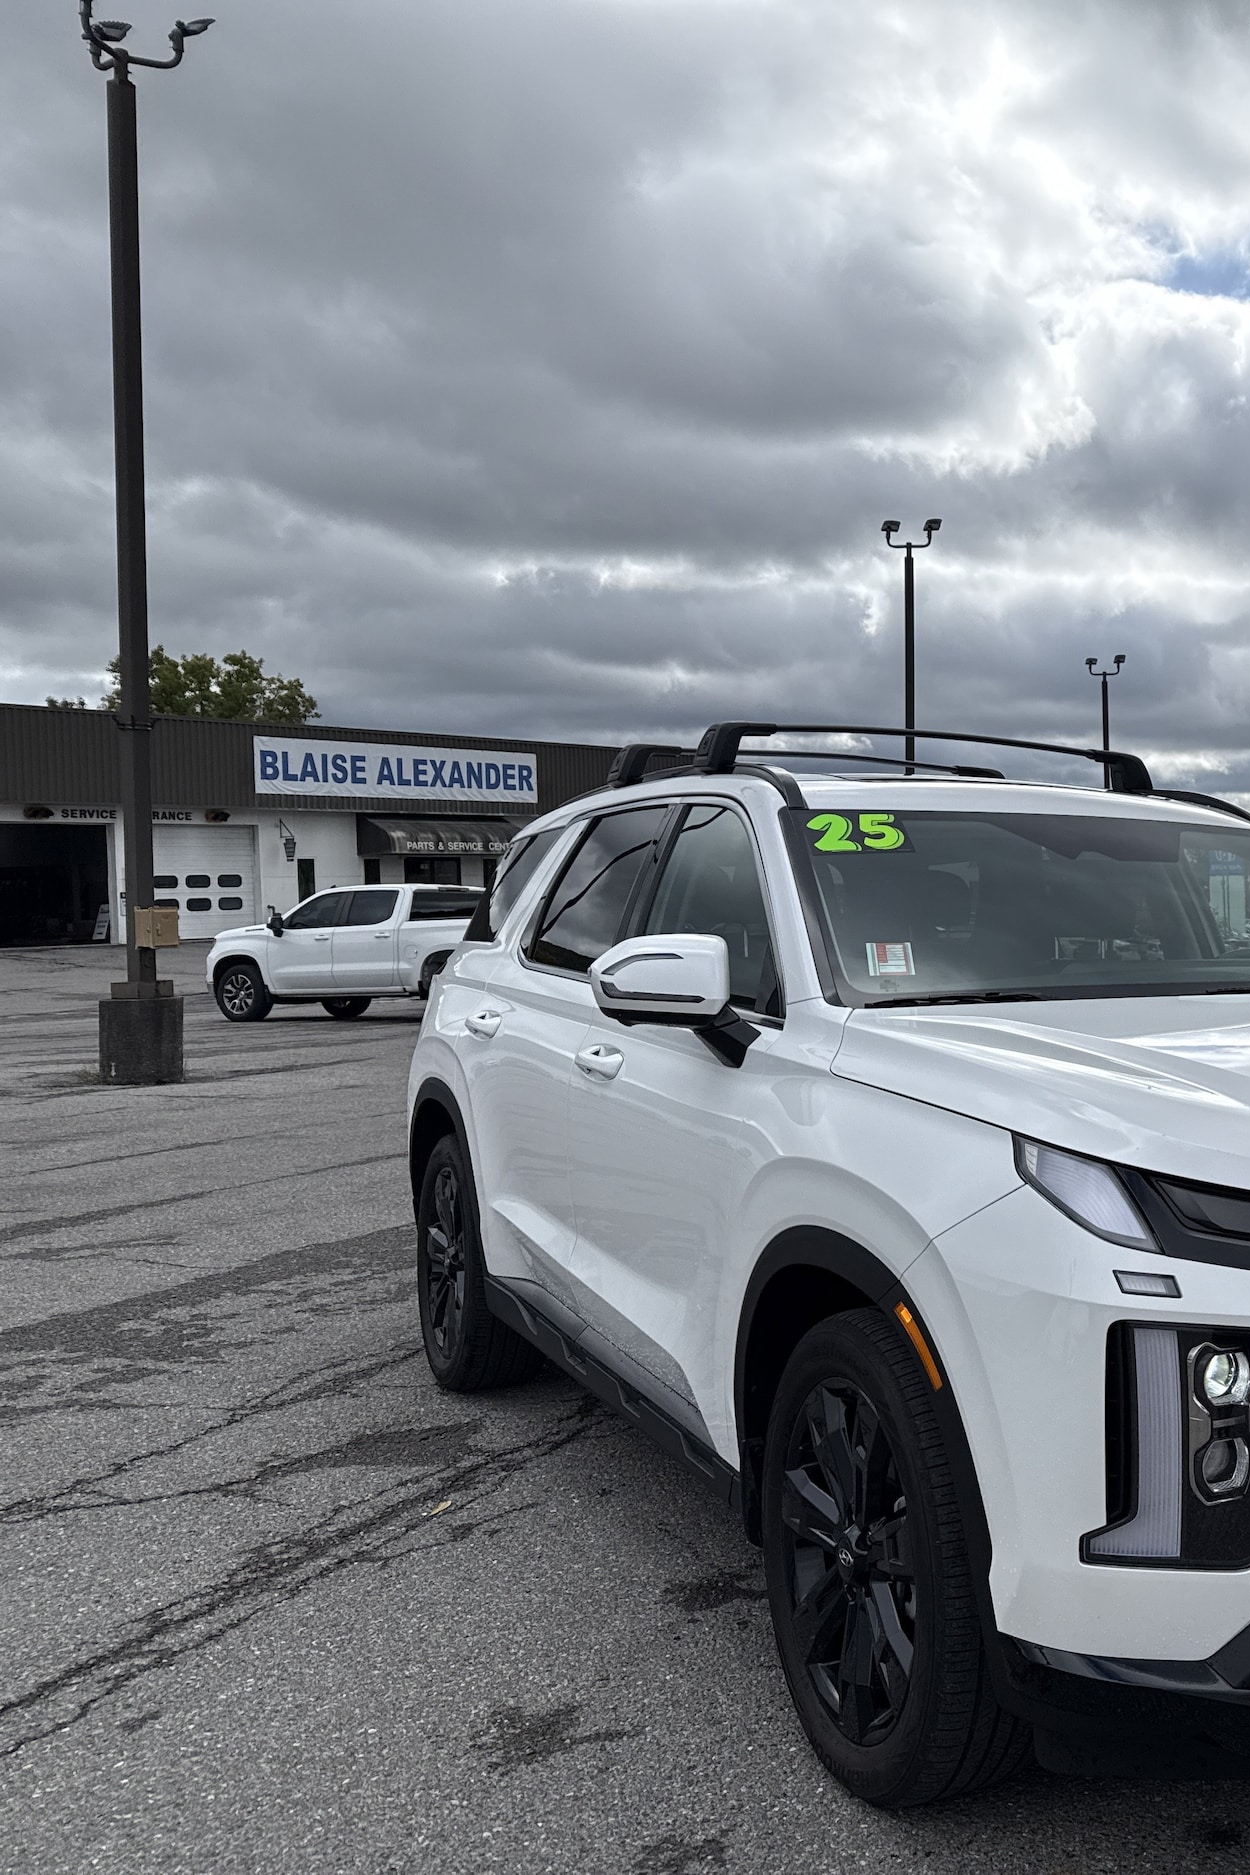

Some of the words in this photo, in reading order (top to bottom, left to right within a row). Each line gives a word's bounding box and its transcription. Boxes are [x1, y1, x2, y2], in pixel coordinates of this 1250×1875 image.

[259, 749, 367, 785] BLAISE
[376, 756, 534, 791] ALEXANDER
[61, 808, 117, 819] SERVICE
[152, 811, 192, 821] RANCE
[805, 813, 905, 852] 25
[406, 841, 435, 851] PARTS
[438, 841, 445, 851] &
[447, 841, 484, 851] SERVICE
[488, 842, 512, 851] CENT
